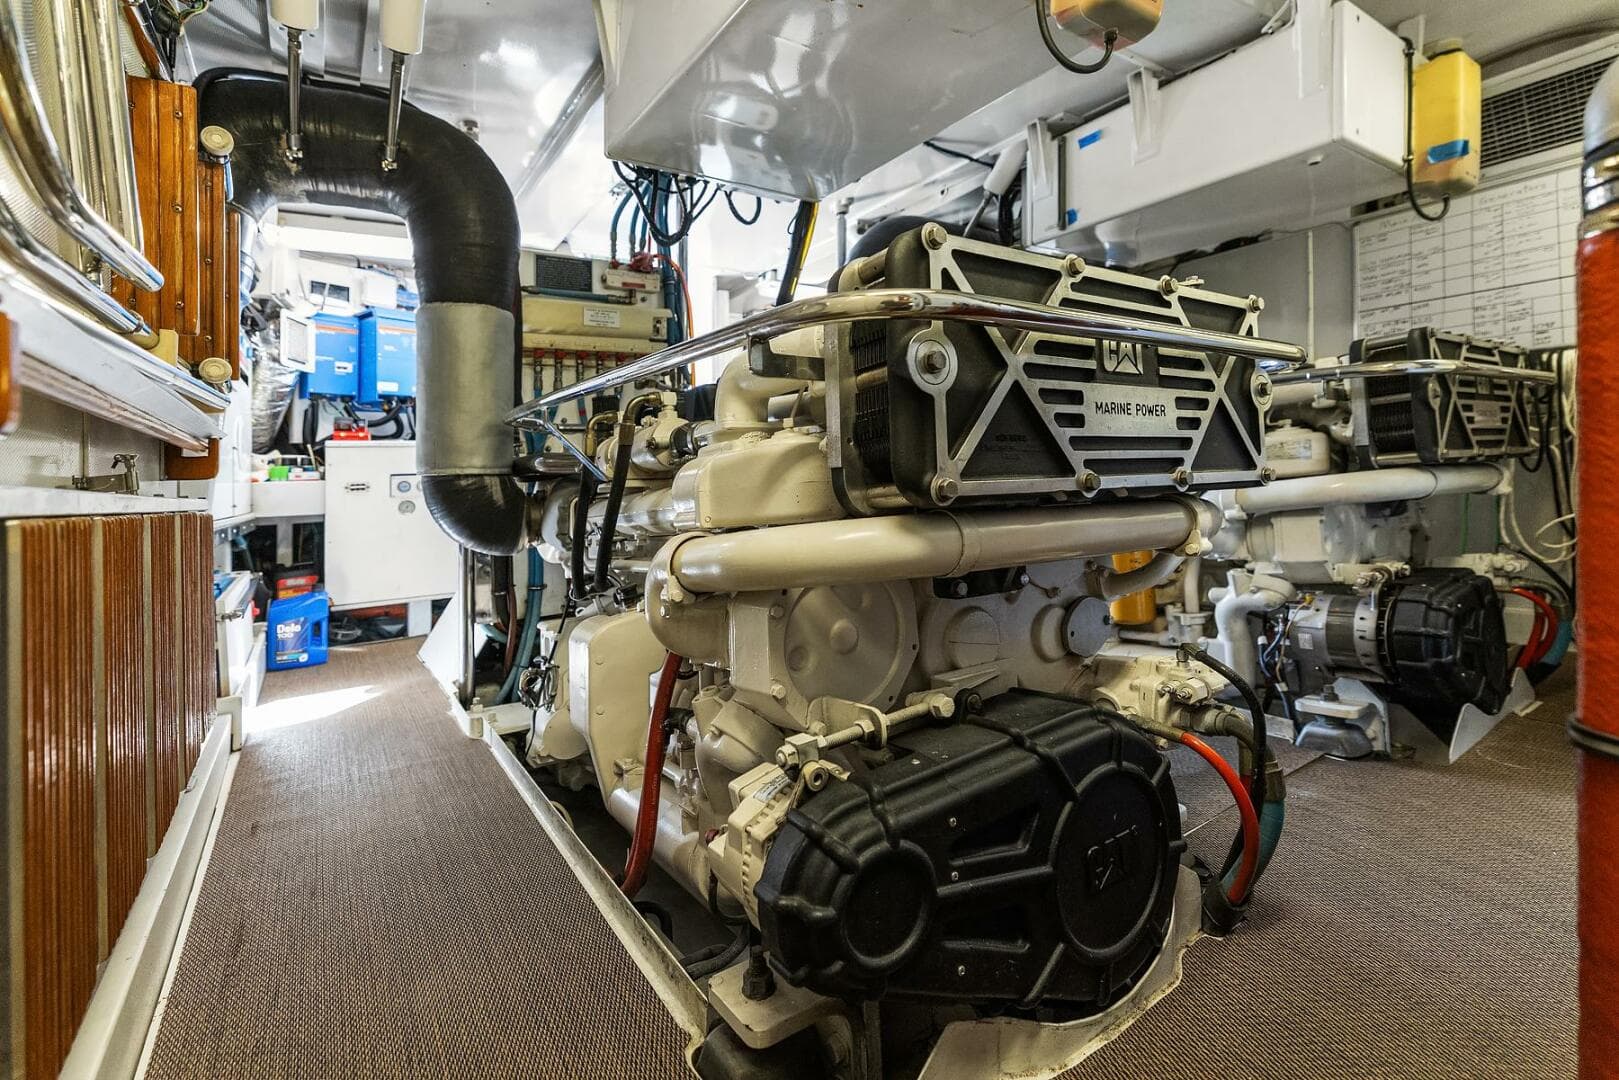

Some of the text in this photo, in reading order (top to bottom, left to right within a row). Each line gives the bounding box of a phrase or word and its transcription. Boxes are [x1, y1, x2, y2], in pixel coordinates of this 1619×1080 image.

[1102, 339, 1144, 375] CAT
[1095, 401, 1166, 417] MARINE POWER
[277, 623, 302, 633] Delo
